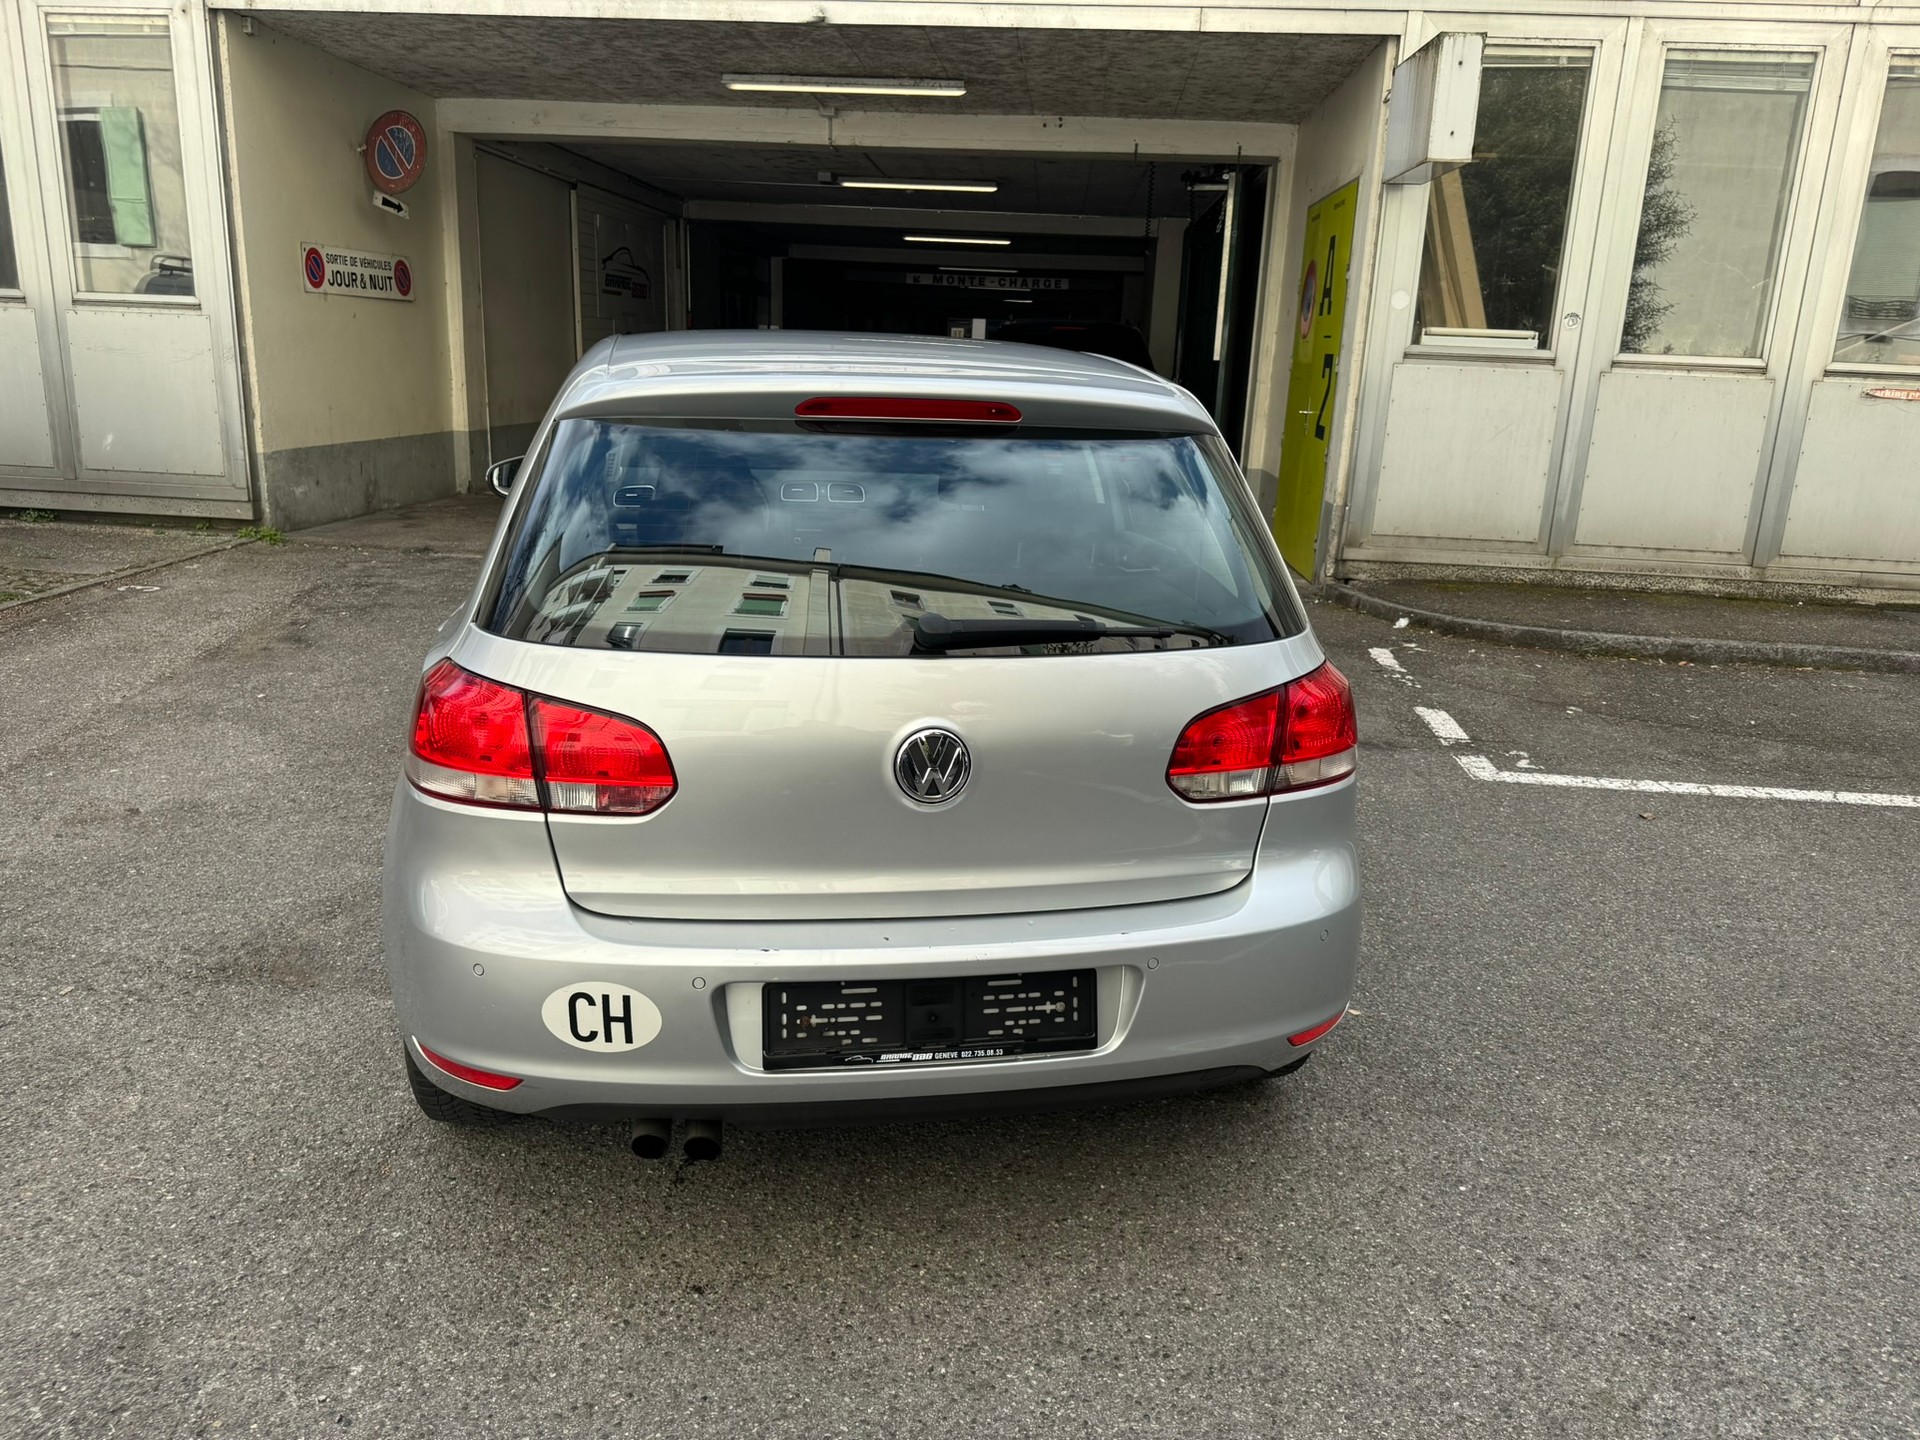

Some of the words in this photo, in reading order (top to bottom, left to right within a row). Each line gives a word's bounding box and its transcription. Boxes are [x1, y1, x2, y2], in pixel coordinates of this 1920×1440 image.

[325, 253, 349, 266] SORTIE
[350, 256, 359, 268] DE
[359, 256, 393, 272] VÉHICULES
[328, 270, 358, 288] JOUR
[360, 273, 367, 289] &
[369, 274, 393, 291] NUIT
[932, 274, 1063, 289] MONTE-CHARGE
[1319, 234, 1336, 316] A
[568, 991, 633, 1044] CH
